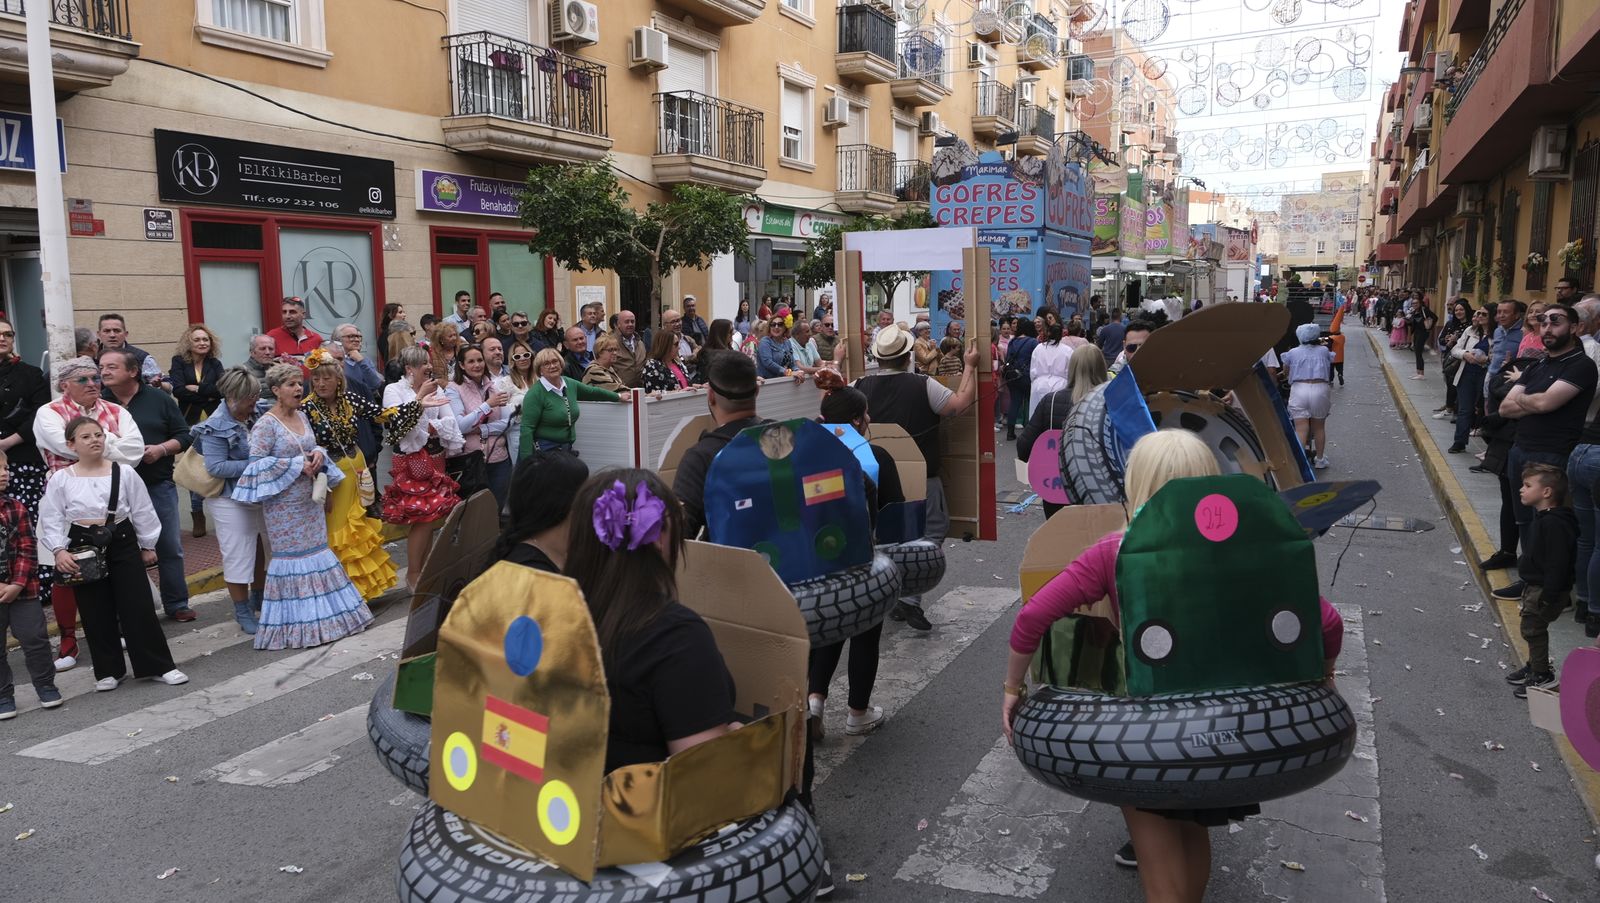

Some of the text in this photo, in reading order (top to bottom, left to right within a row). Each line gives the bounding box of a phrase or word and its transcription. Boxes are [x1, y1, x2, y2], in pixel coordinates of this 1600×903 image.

[470, 179, 493, 193] Frutas
[493, 183, 498, 196] y
[935, 182, 1038, 204] GOFRES
[268, 196, 290, 204] 697
[294, 198, 315, 207] 232
[319, 201, 339, 209] 106
[1047, 185, 1092, 232] GOFRES
[935, 205, 1036, 226] CREPES
[297, 260, 362, 320] KB
[1202, 506, 1226, 530] 24
[1190, 730, 1240, 748] INTEX
[442, 811, 475, 844] PER
[466, 842, 547, 874] HIGH
